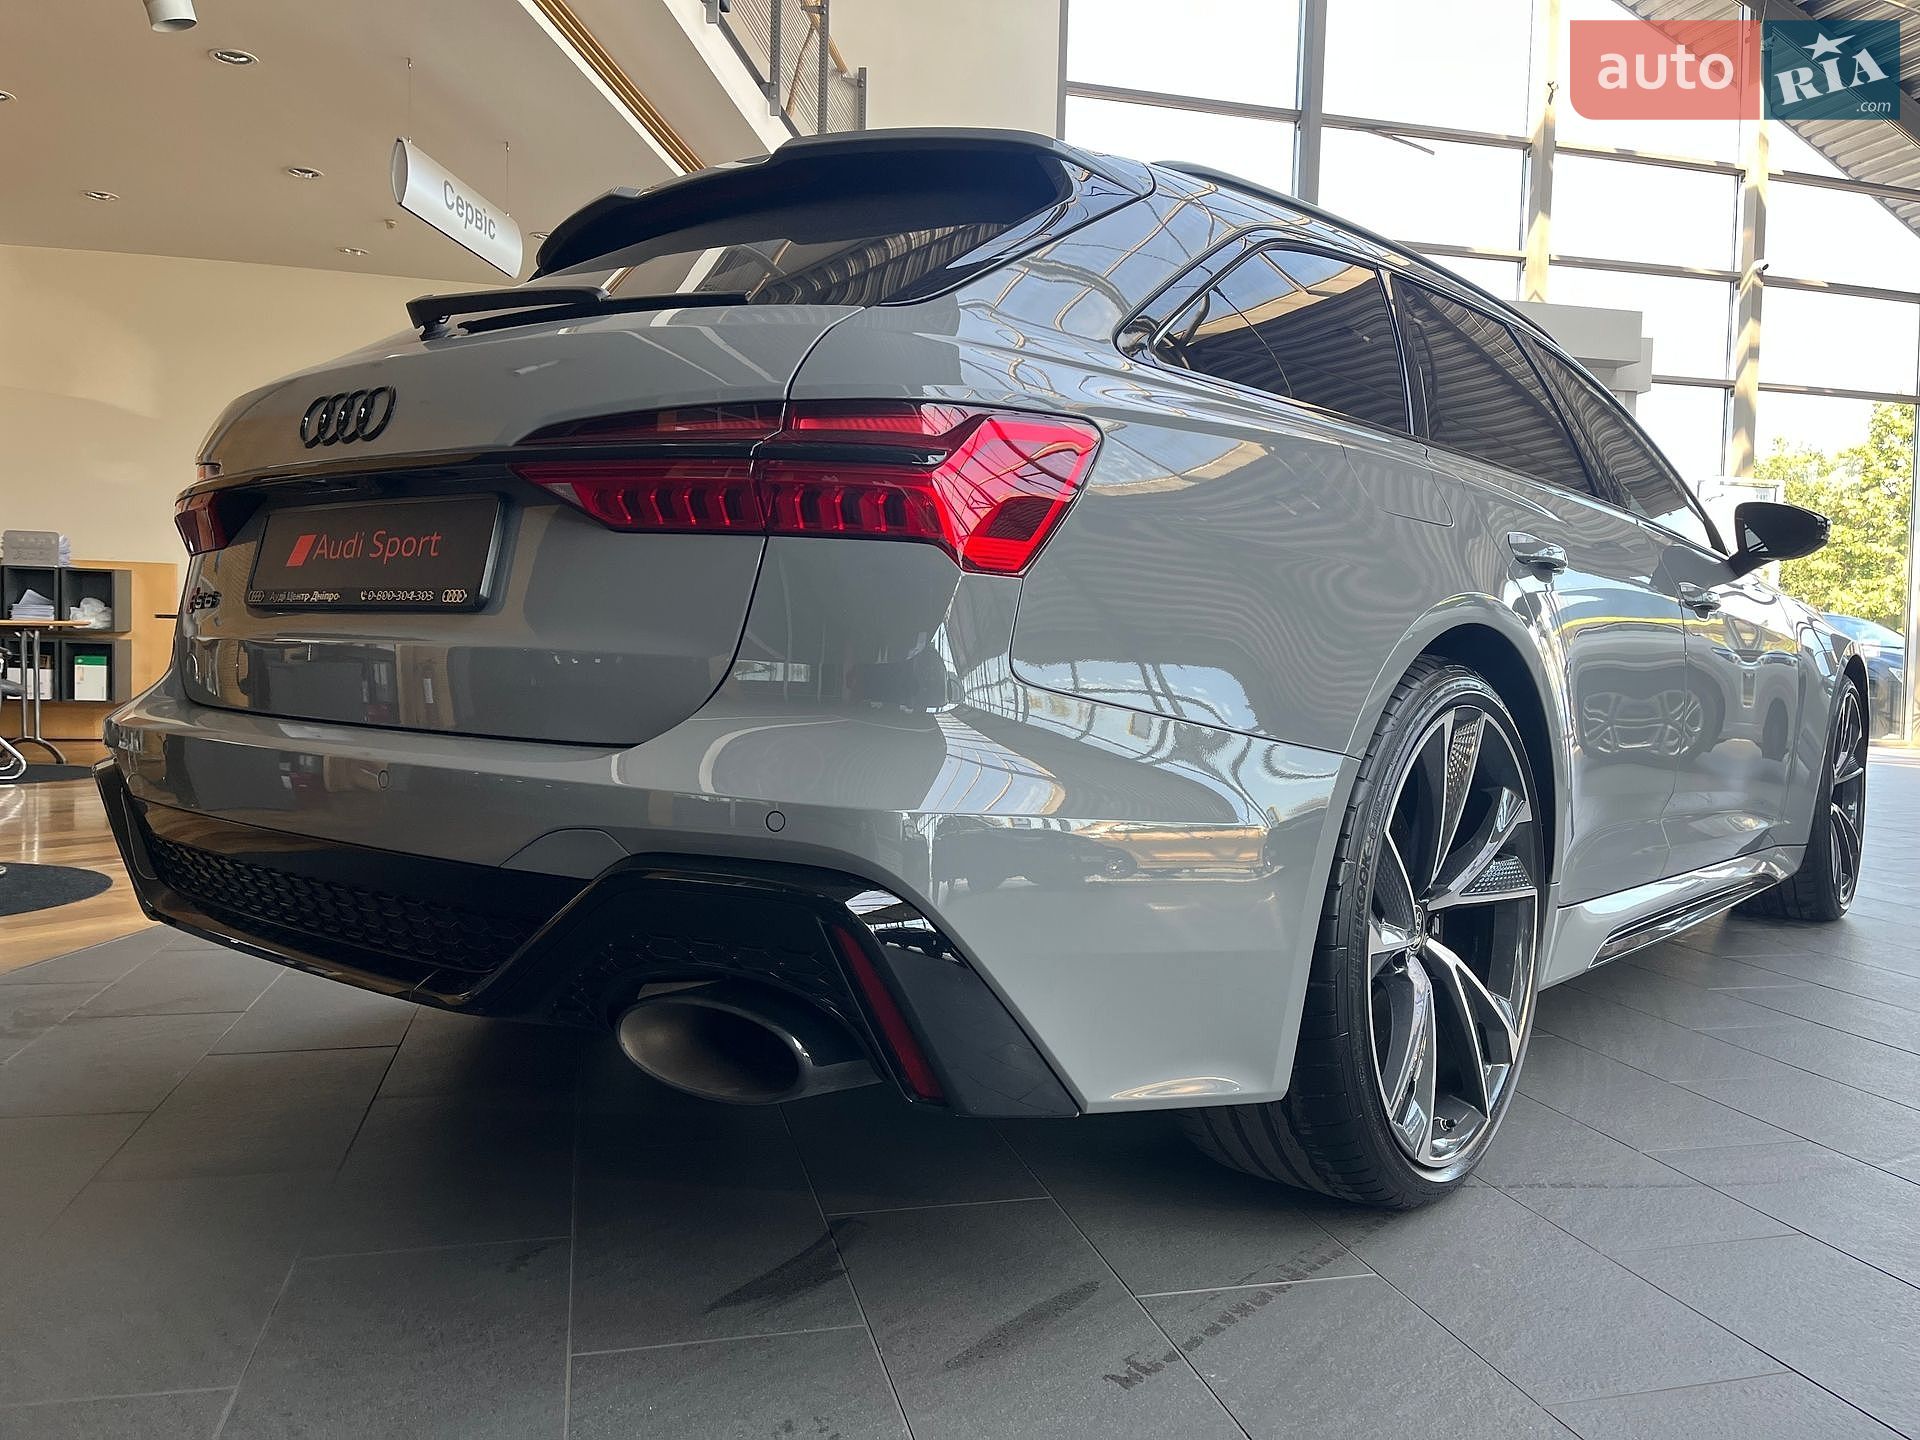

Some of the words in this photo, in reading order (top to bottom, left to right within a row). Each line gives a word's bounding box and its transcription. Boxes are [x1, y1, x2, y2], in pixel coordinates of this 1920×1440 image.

[443, 180, 496, 240] Сервіс
[312, 531, 365, 561] Audi
[369, 529, 442, 565] Sport
[310, 590, 339, 603] Дніпро
